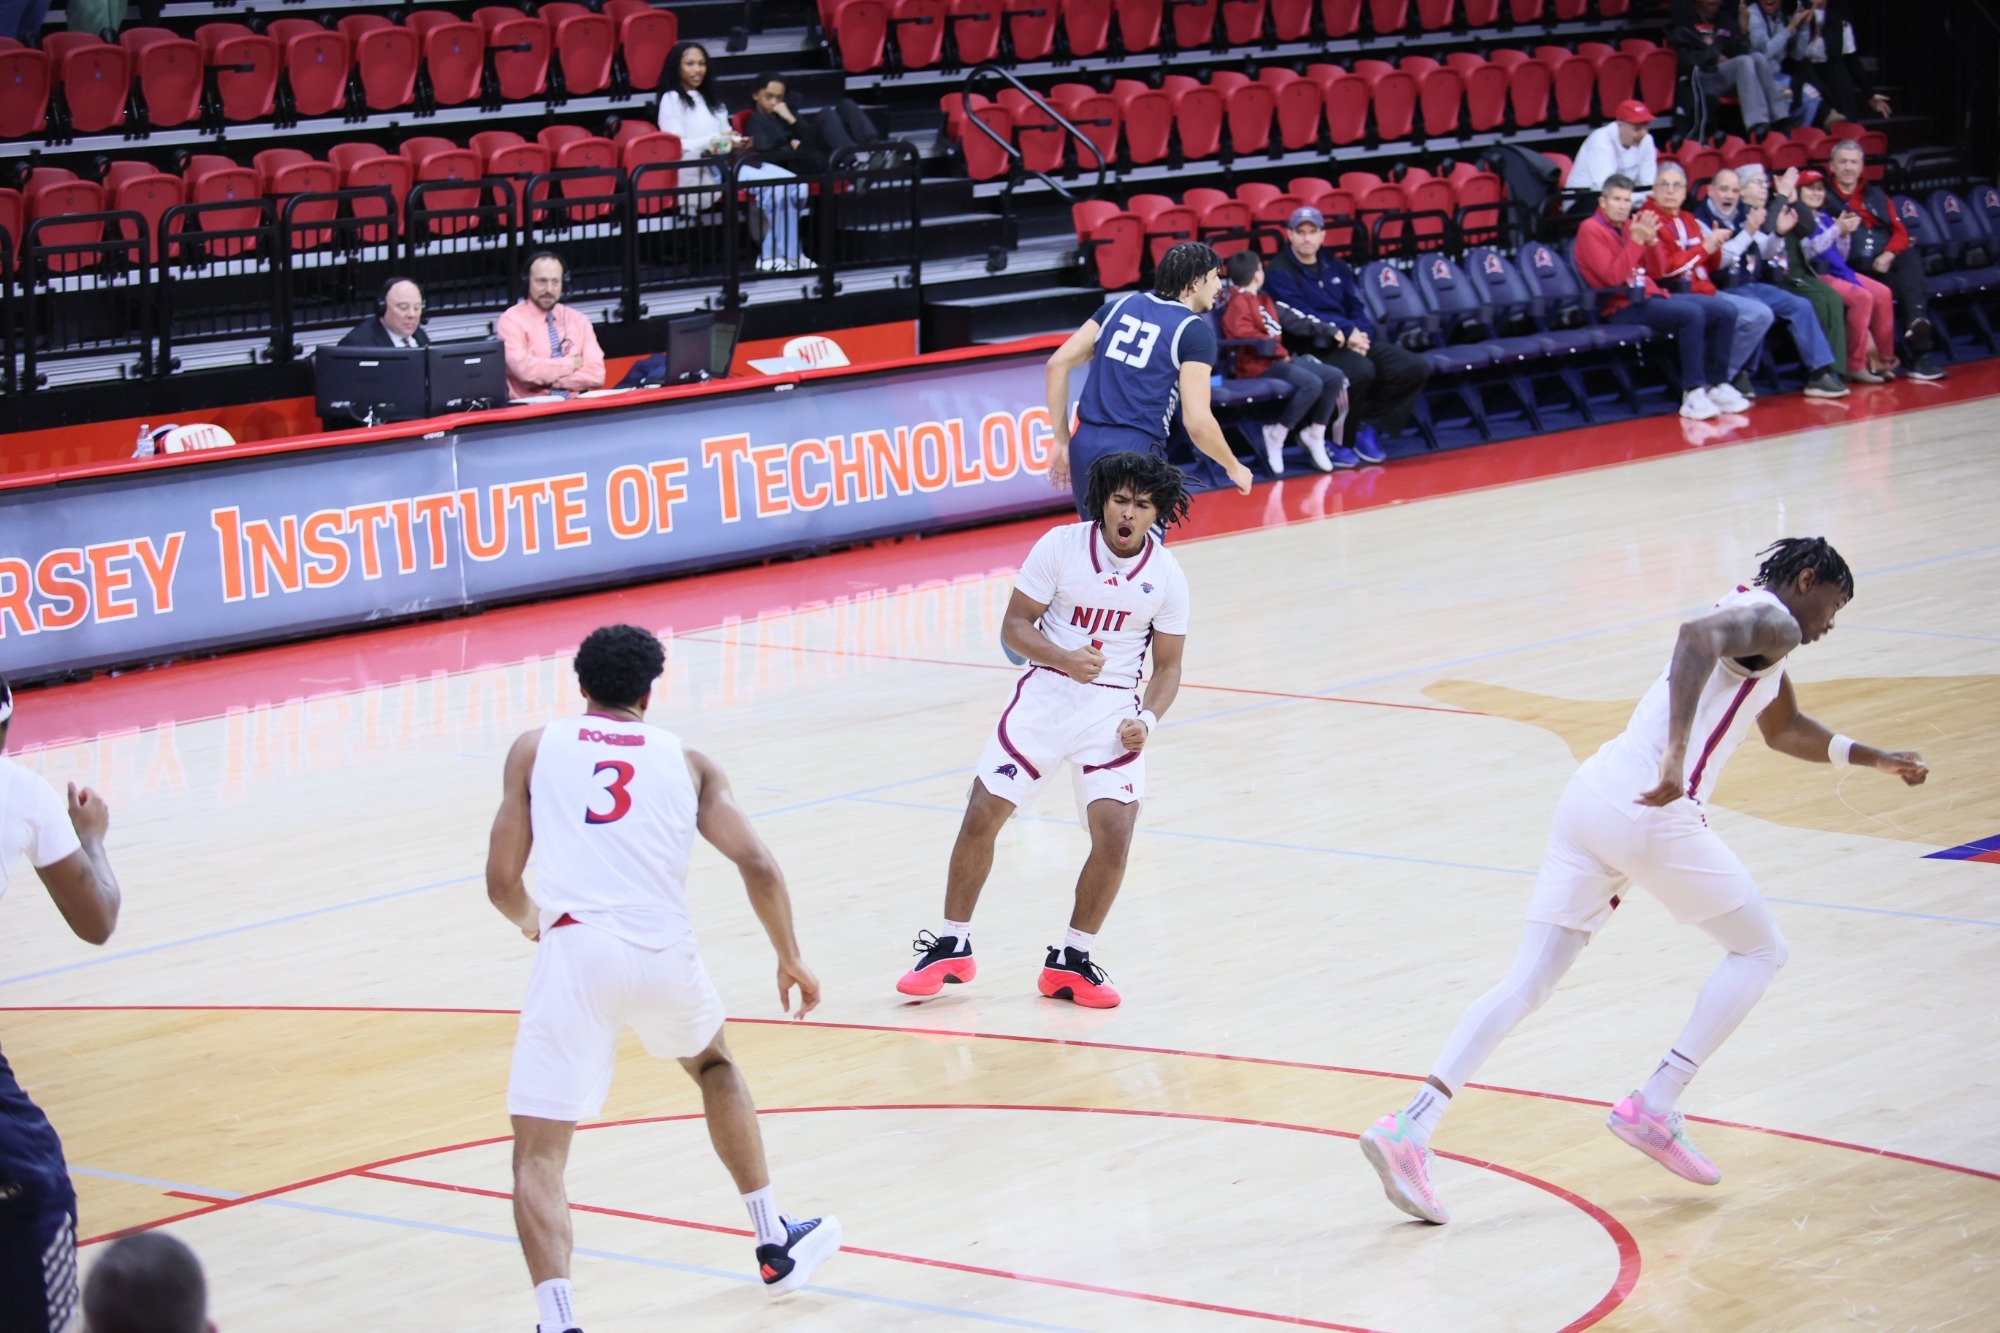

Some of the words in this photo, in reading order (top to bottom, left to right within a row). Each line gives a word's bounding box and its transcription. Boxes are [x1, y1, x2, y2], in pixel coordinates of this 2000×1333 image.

[797, 340, 829, 366] NJIT
[1105, 313, 1161, 369] 23
[606, 457, 689, 540] OF
[701, 401, 1080, 524] TECHNOLOG
[1070, 605, 1132, 636] NJIT
[584, 760, 635, 825] 3
